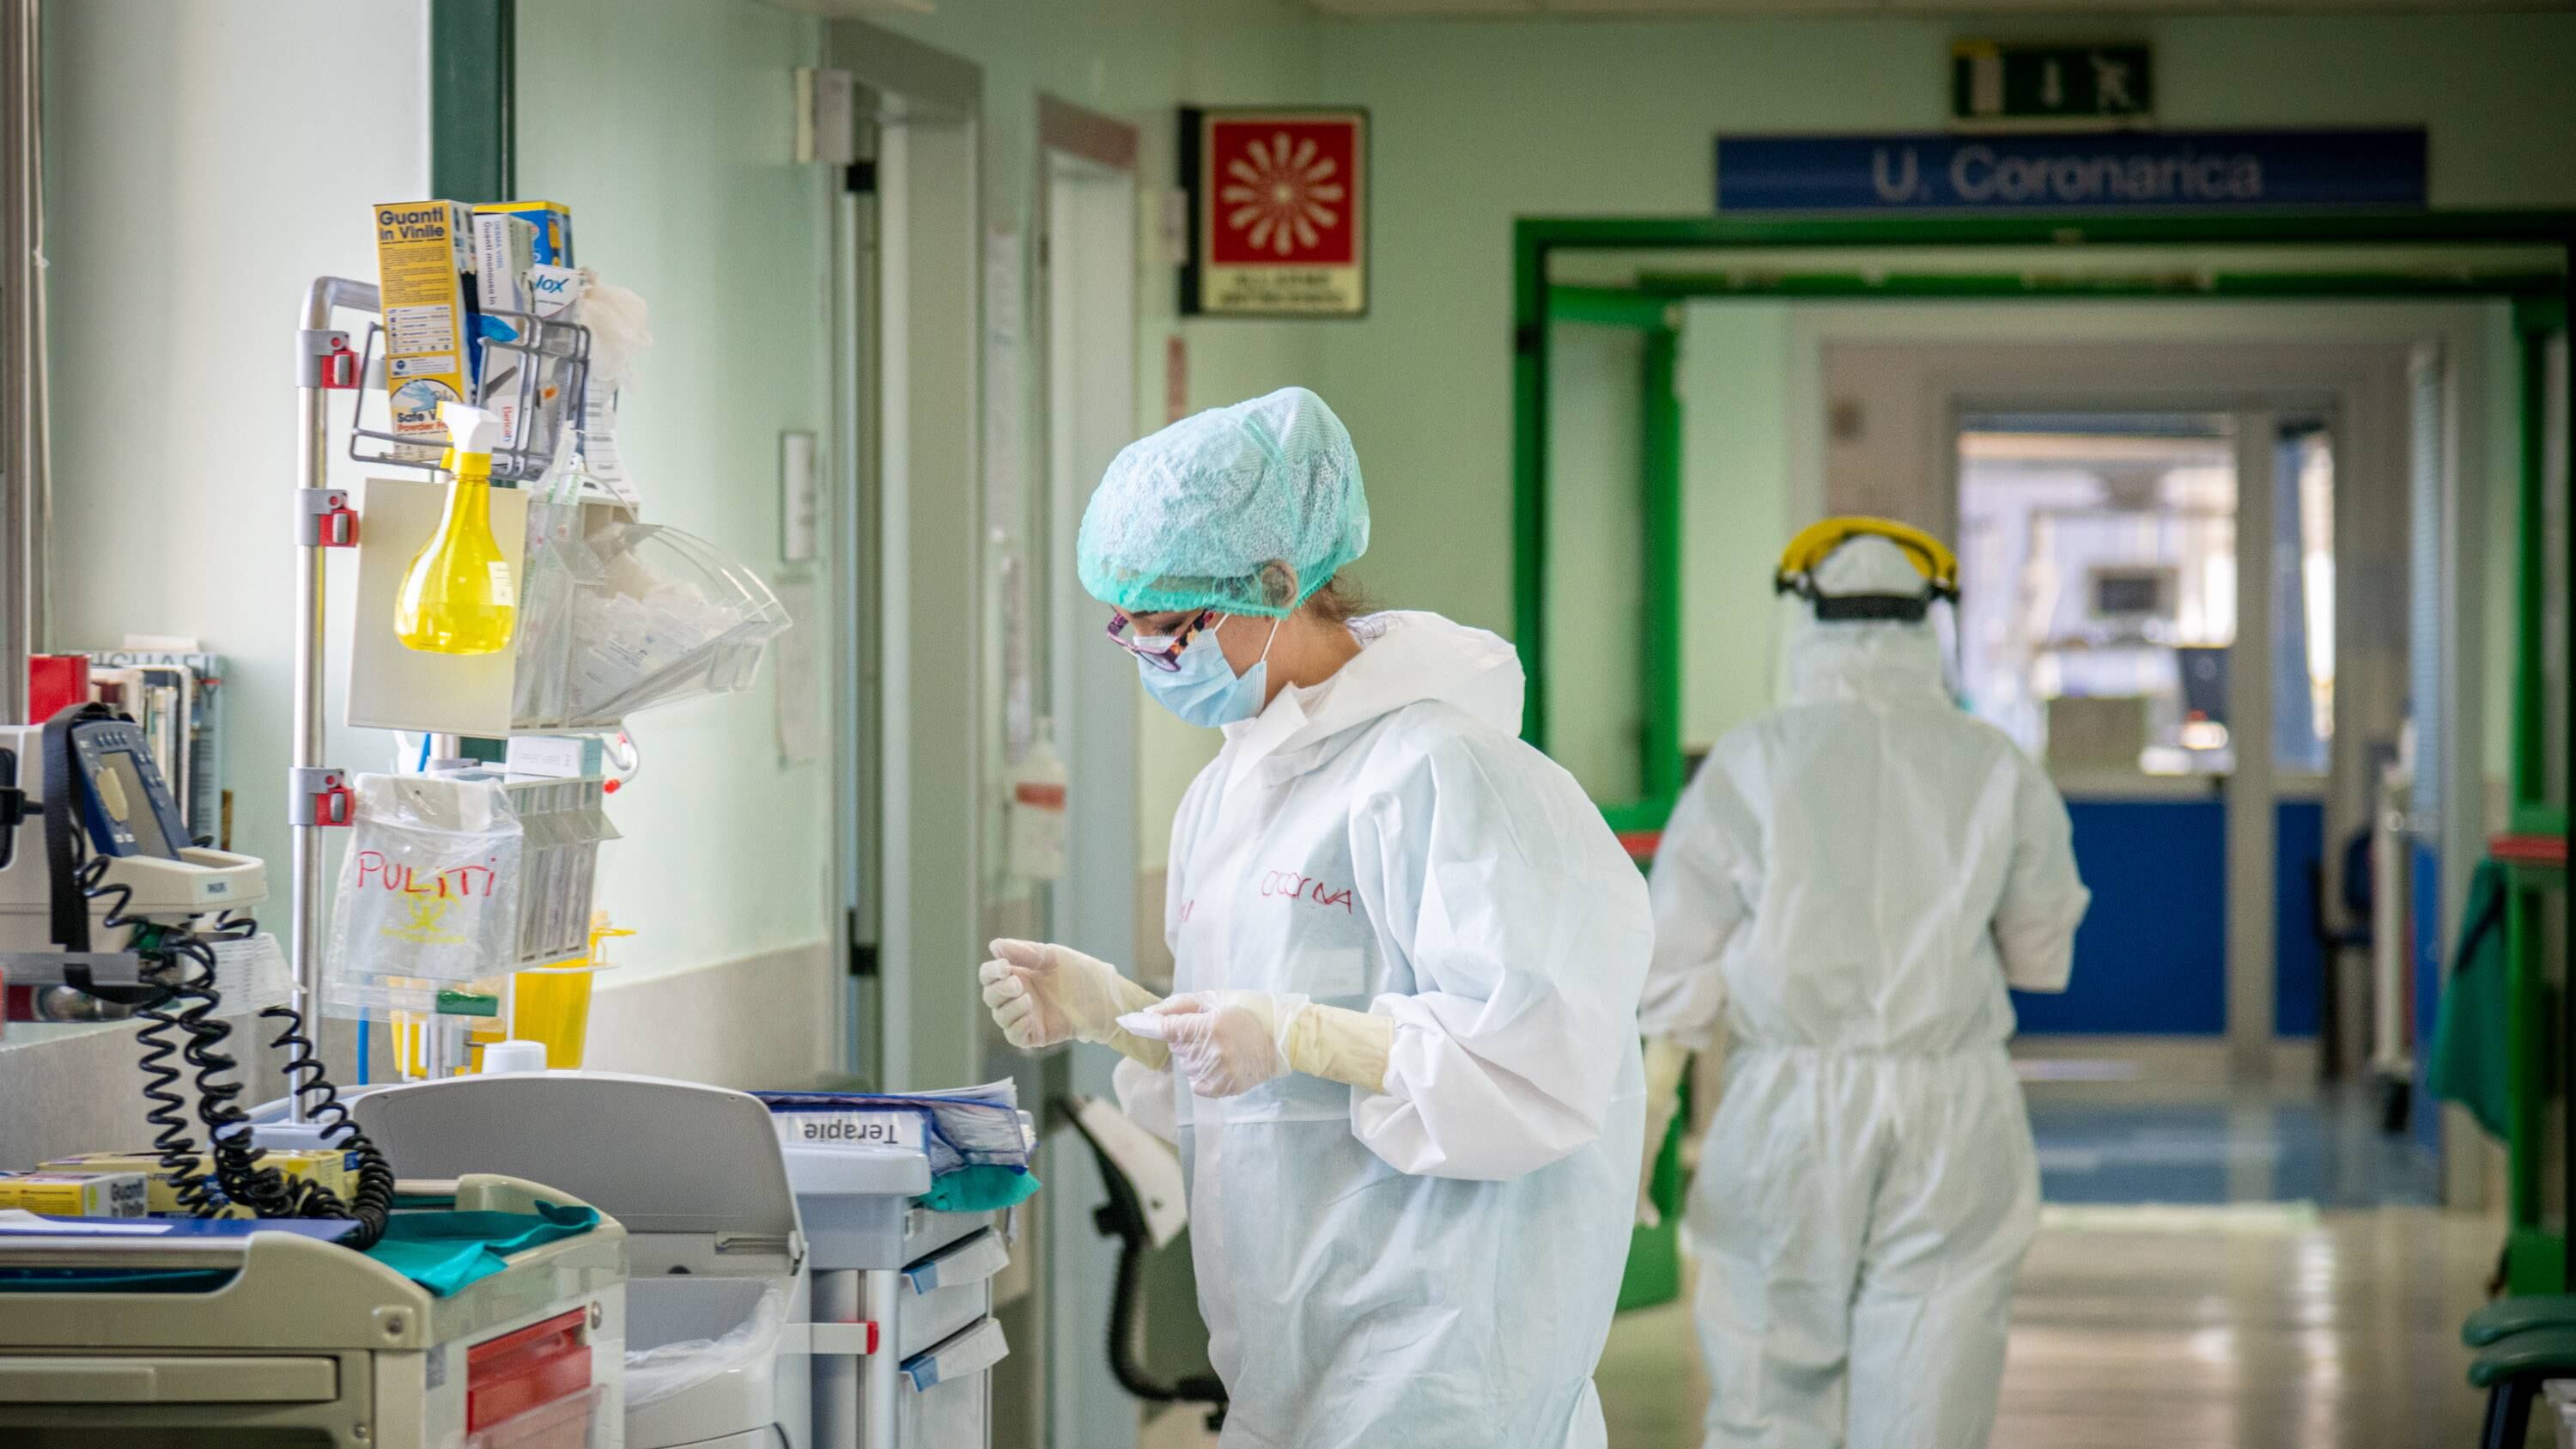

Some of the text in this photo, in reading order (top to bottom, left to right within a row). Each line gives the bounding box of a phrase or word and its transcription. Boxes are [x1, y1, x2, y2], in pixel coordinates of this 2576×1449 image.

[1949, 144, 2265, 203] Coronarica
[379, 207, 444, 225] Guanti
[380, 225, 445, 240] in Vinile
[397, 411, 425, 423] Safe
[804, 1118, 899, 1145] Terapie
